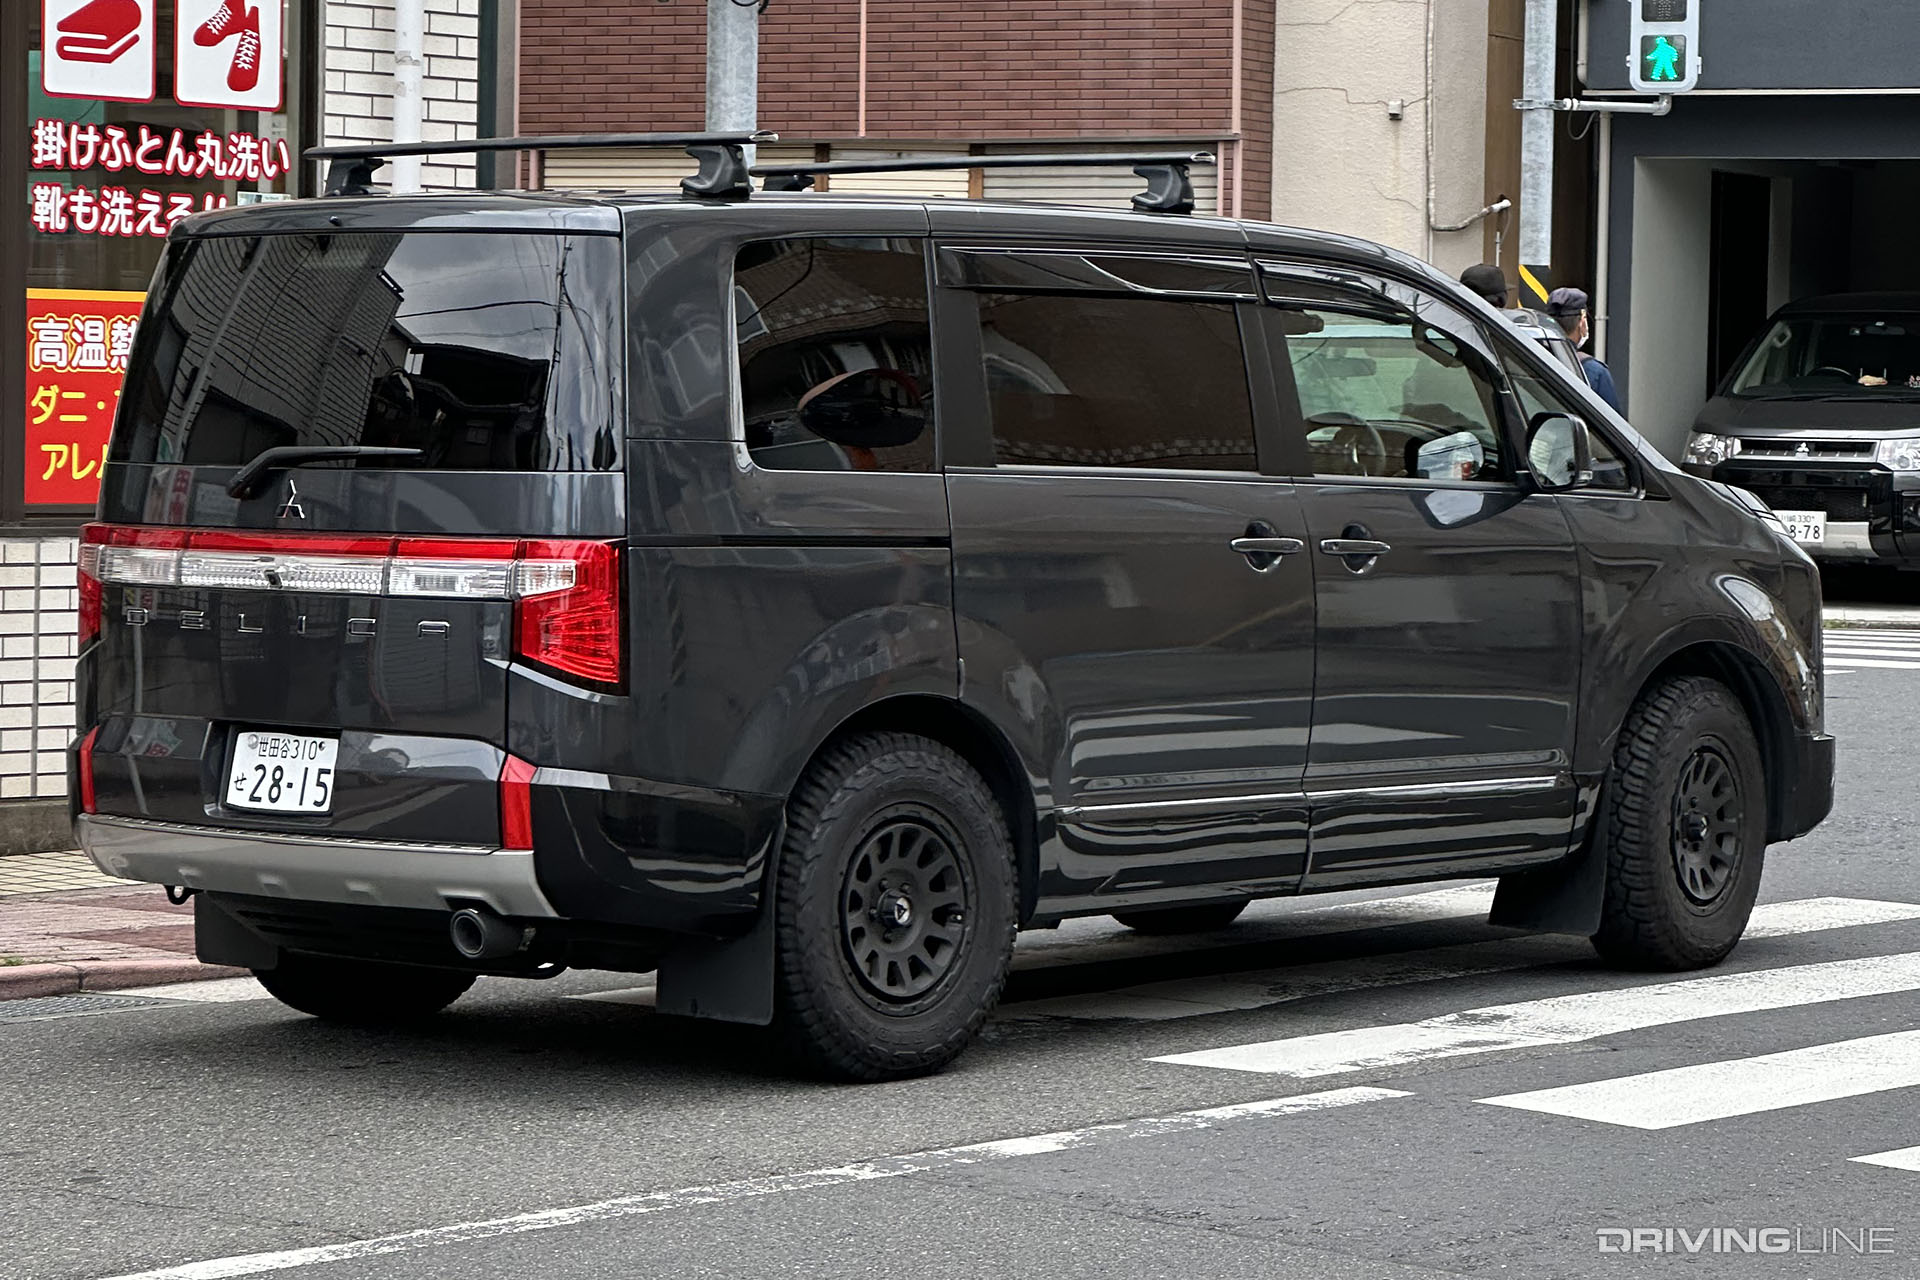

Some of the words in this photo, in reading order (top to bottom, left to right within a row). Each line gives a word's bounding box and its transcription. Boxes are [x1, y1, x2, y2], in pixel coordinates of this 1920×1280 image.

[33, 119, 290, 179] 掛けふとん丸洗い
[31, 385, 120, 425] ダニ・
[126, 607, 450, 640] DELICA
[234, 772, 248, 791] せ
[248, 763, 332, 807] 28-15
